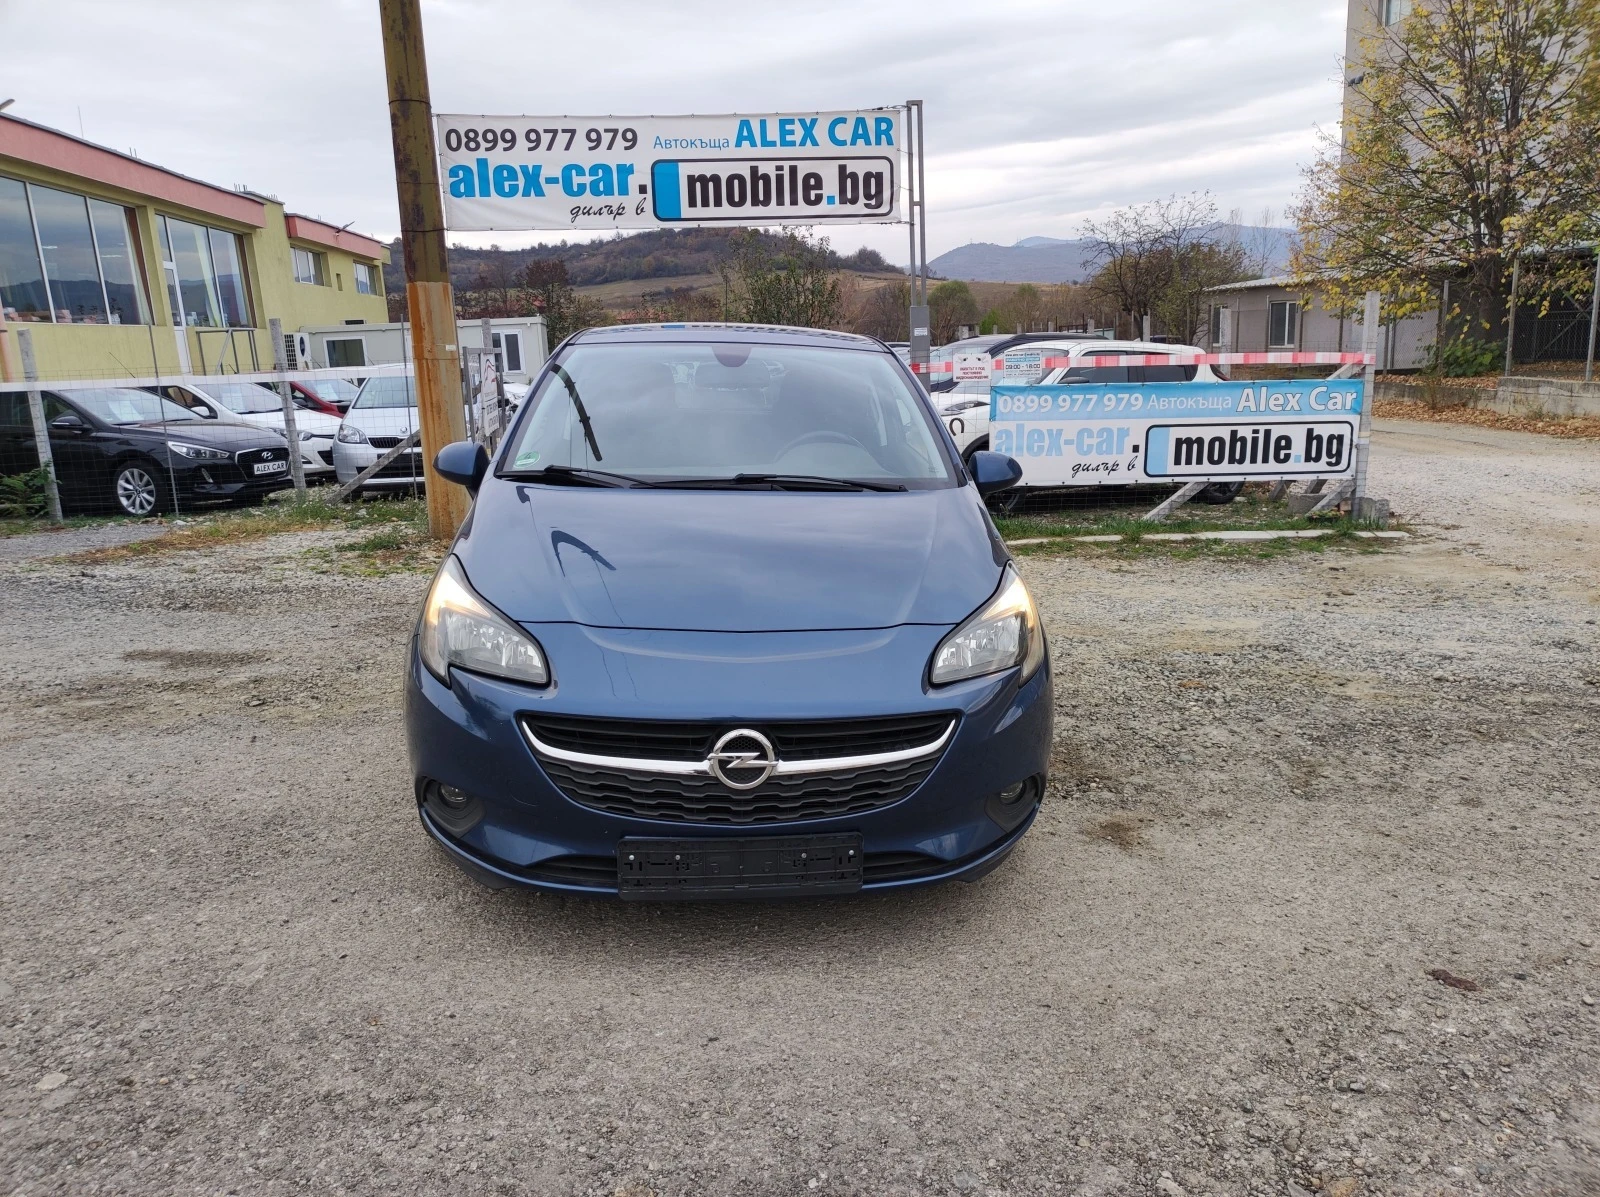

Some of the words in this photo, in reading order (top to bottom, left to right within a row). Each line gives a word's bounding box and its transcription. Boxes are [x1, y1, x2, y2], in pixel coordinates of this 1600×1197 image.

[445, 128, 517, 152] 0899
[524, 128, 577, 152] 977
[585, 127, 638, 151] 979
[735, 118, 820, 148] ALEX
[827, 116, 894, 146] CAR
[653, 135, 730, 151] Автокъща
[687, 164, 884, 210] mobile.bg
[570, 202, 627, 223] дилър
[1000, 395, 1053, 413] 0899
[1058, 394, 1098, 412] 977
[1103, 393, 1143, 412] 979
[1146, 394, 1232, 411] Автокъща
[1236, 386, 1303, 412] Alex
[1309, 386, 1357, 411] Car
[1173, 427, 1345, 467] mobile.bg
[256, 464, 270, 472] ALEX
[272, 462, 285, 470] CAR
[1071, 459, 1120, 478] дилър
